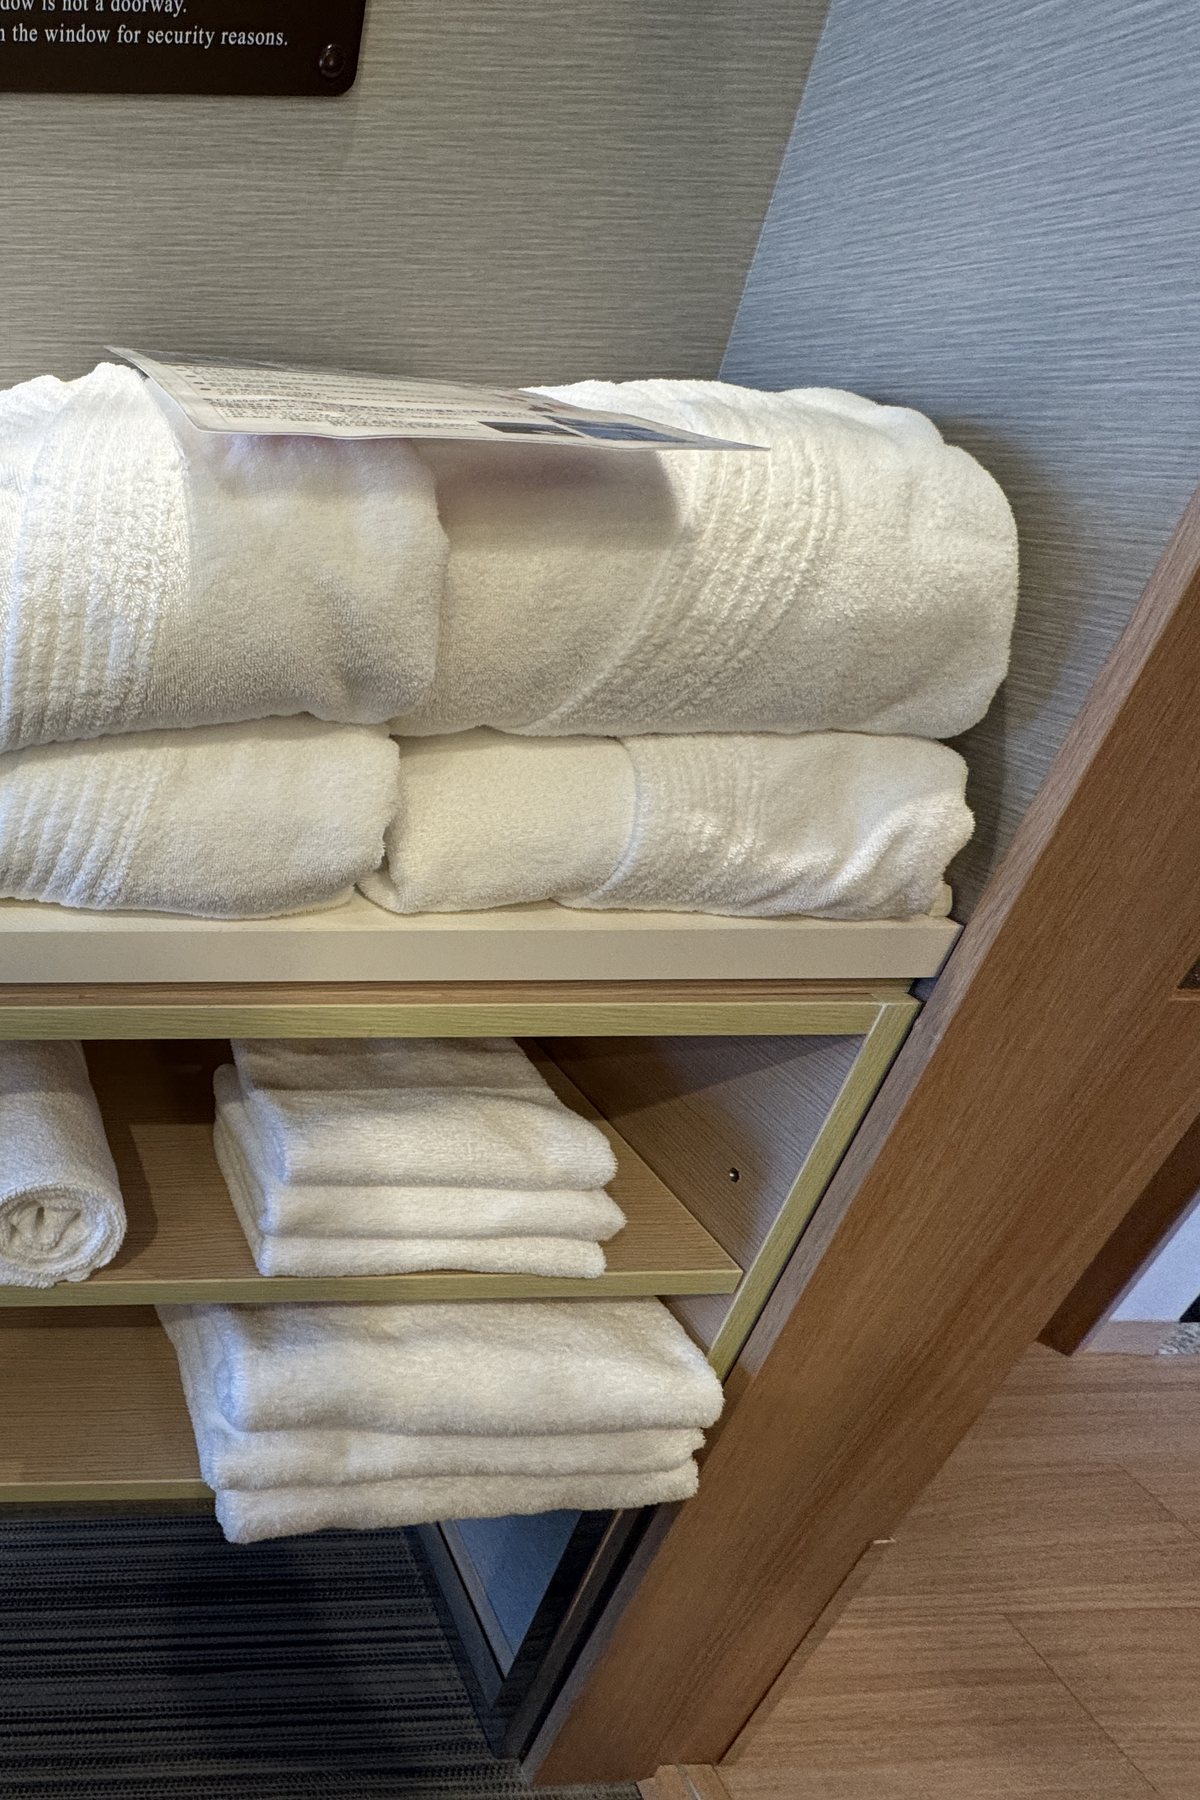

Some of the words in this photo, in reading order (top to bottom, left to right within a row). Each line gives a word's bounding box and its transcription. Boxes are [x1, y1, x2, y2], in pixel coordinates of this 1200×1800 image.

[62, 0, 89, 12] not
[95, 0, 104, 12] a
[110, 0, 187, 17] doorway.
[12, 22, 38, 42] the
[45, 24, 111, 44] window
[117, 24, 142, 44] for
[146, 25, 216, 49] security
[221, 31, 288, 46] reasons.
